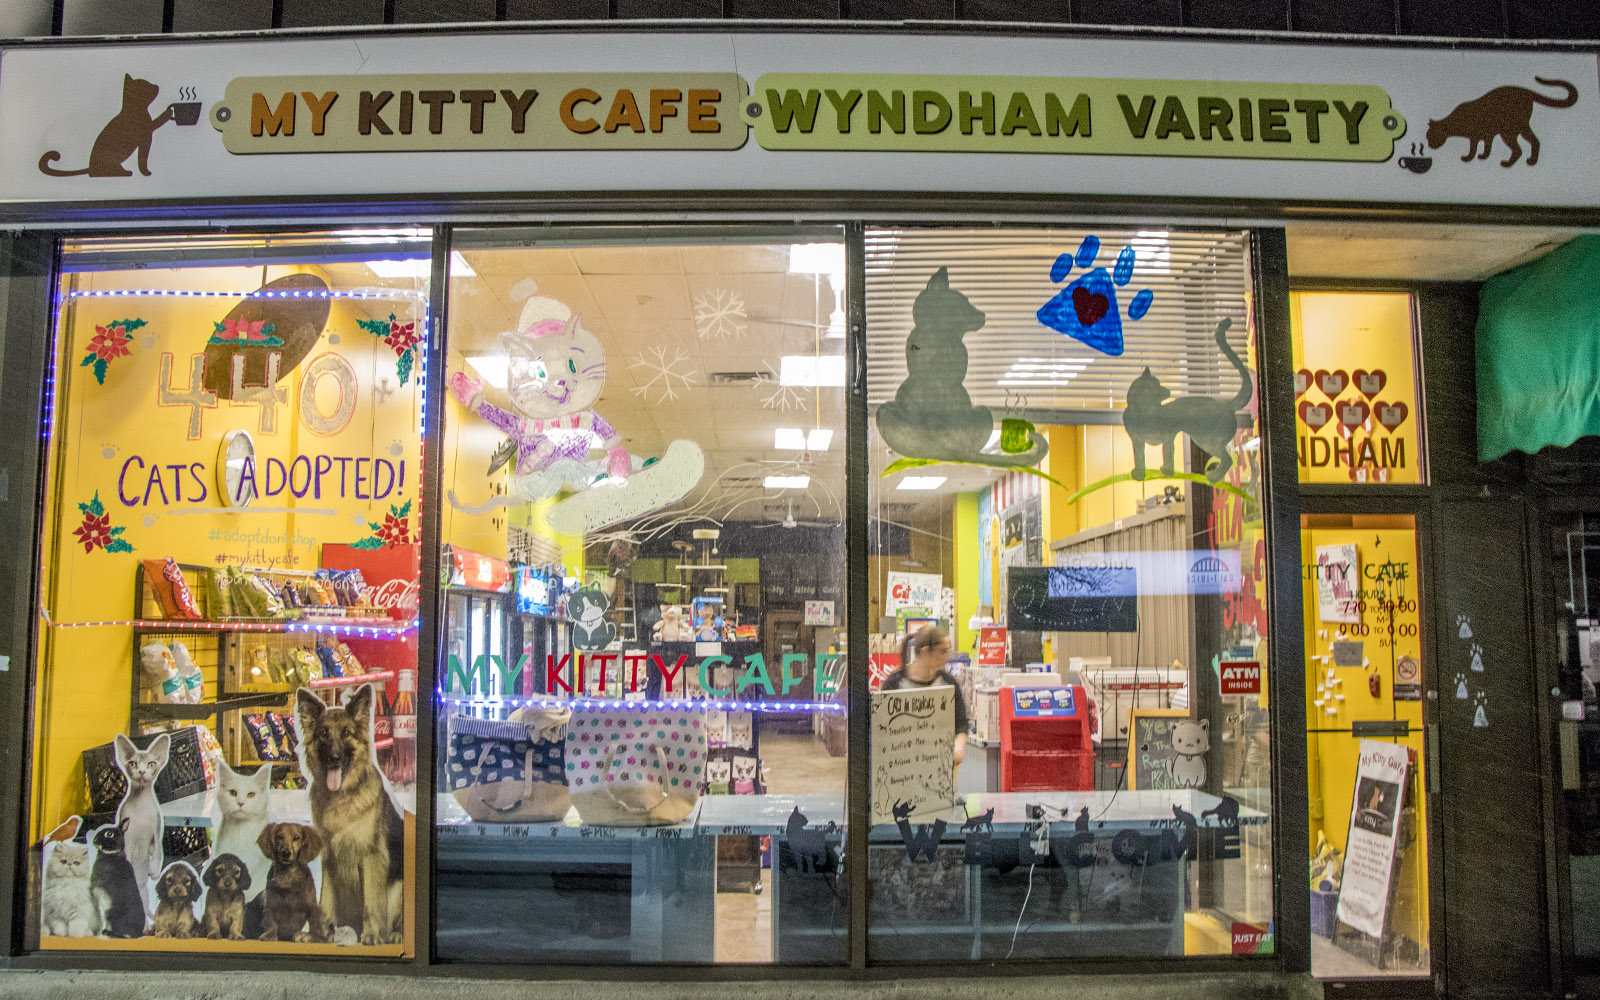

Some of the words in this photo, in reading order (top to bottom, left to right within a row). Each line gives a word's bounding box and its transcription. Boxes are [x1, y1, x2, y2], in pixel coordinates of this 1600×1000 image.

[249, 92, 339, 137] MY
[357, 89, 539, 135] KITTY
[558, 87, 722, 134] CAFE
[765, 88, 1093, 138] WYNDHAM
[1116, 93, 1370, 145] VARIETY
[117, 455, 208, 507] CATS
[235, 454, 406, 502] ADOPTED!
[446, 653, 530, 696] MY
[546, 654, 689, 694] KITTY
[697, 653, 840, 696] CAFE
[1222, 667, 1259, 680] ATM
[1361, 755, 1371, 767] My
[1372, 751, 1386, 764] Kitty
[897, 817, 1241, 868] WELCOME
[1234, 934, 1255, 944] JUST
[1255, 933, 1272, 943] EAT
